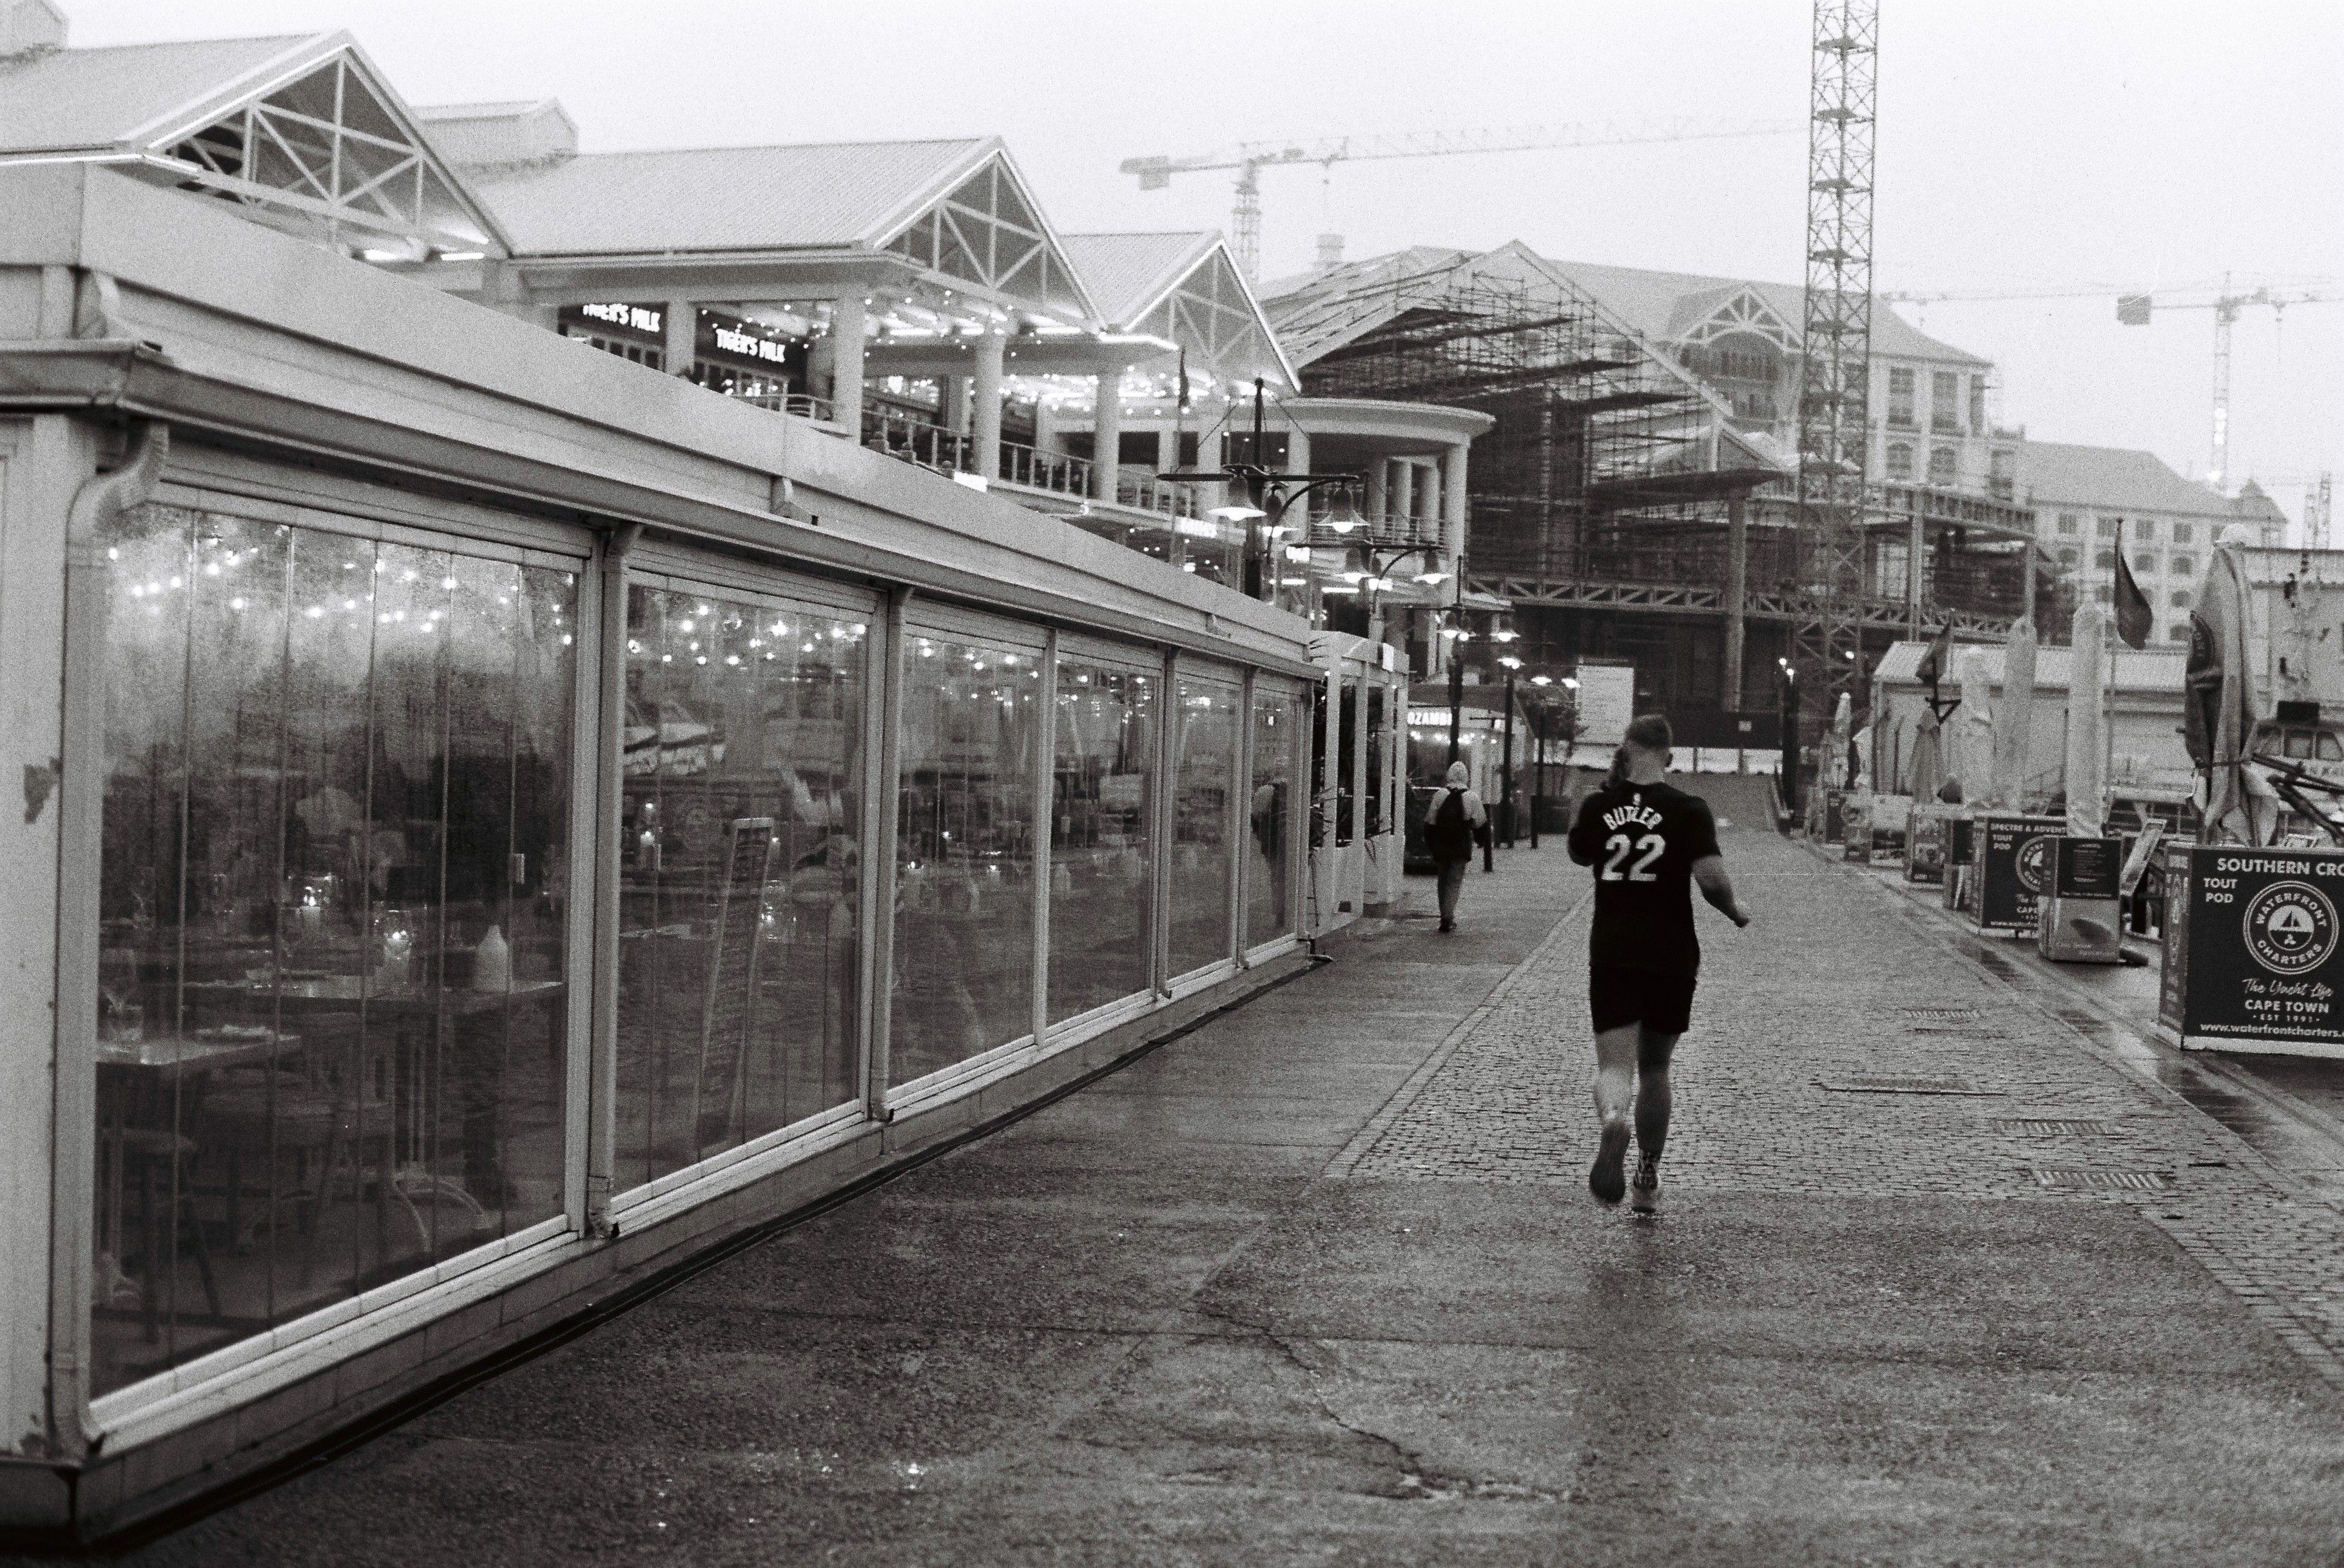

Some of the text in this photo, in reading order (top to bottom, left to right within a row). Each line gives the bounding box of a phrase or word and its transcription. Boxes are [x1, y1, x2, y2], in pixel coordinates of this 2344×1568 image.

[1603, 806, 1663, 831] BUTLER
[1601, 834, 1666, 881] 22
[2217, 857, 2310, 875] SOUTHERN
[2203, 877, 2238, 889] TOUT
[2205, 892, 2234, 903] POD
[2256, 893, 2327, 927] WATERFRONT
[2257, 940, 2322, 965] CHARTERS
[2242, 978, 2266, 994] The
[2245, 1000, 2329, 1014] CAPE TOWN
